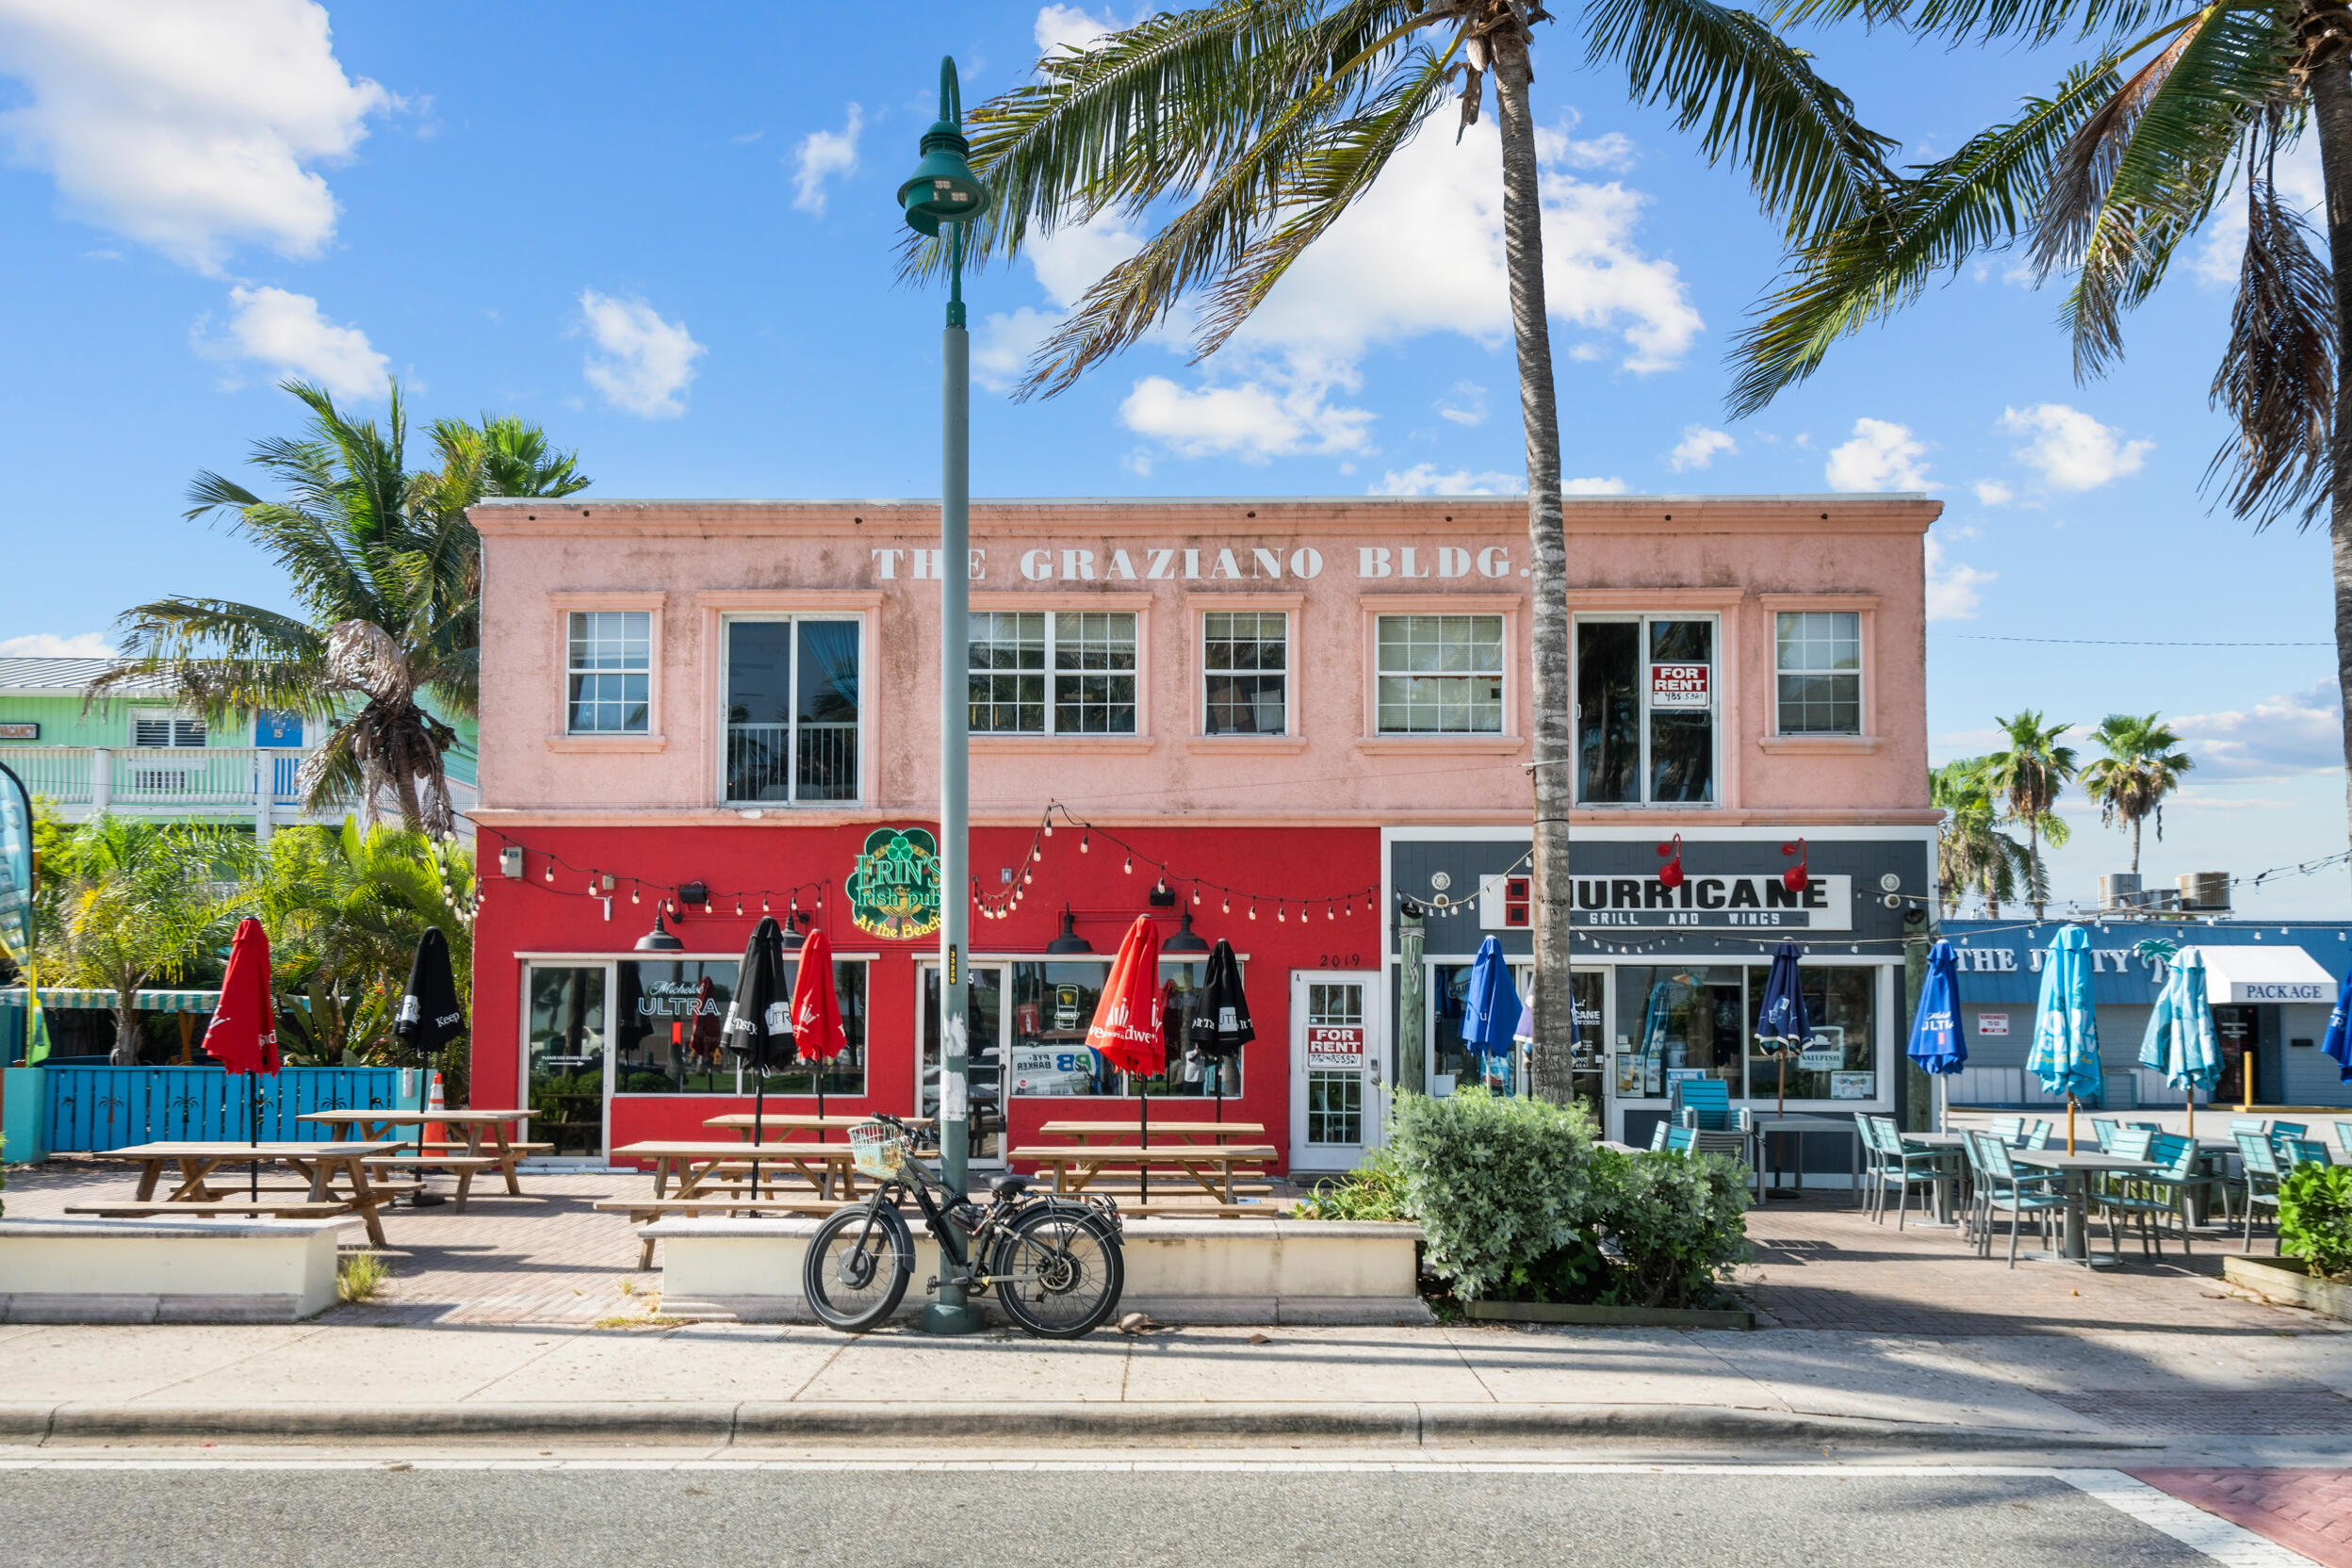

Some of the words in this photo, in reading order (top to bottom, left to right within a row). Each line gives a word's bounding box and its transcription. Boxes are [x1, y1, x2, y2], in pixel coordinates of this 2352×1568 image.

[1021, 547, 1324, 581] GRAZIANO
[1357, 546, 1531, 580] BLDG.
[1660, 668, 1698, 679] FOR
[1655, 679, 1705, 691] RENT
[856, 854, 941, 889] ERIN'S
[856, 887, 898, 906] Irish
[908, 889, 941, 909] pub
[1570, 878, 1829, 909] URRICANE
[855, 914, 874, 932] At
[876, 923, 898, 938] the
[1589, 913, 1639, 925] GRILL
[1668, 913, 1699, 925] AND
[1728, 913, 1780, 925] WINGS
[1320, 953, 1361, 968] 2019
[1955, 948, 2017, 972] THE
[1296, 973, 1300, 982] A
[648, 980, 706, 995] Michelob
[2246, 985, 2323, 999] PACKAGE
[638, 997, 722, 1016] ULTRA
[435, 1012, 460, 1028] Keep
[1316, 1029, 1355, 1041] FOR
[1310, 1041, 1361, 1053] RENT
